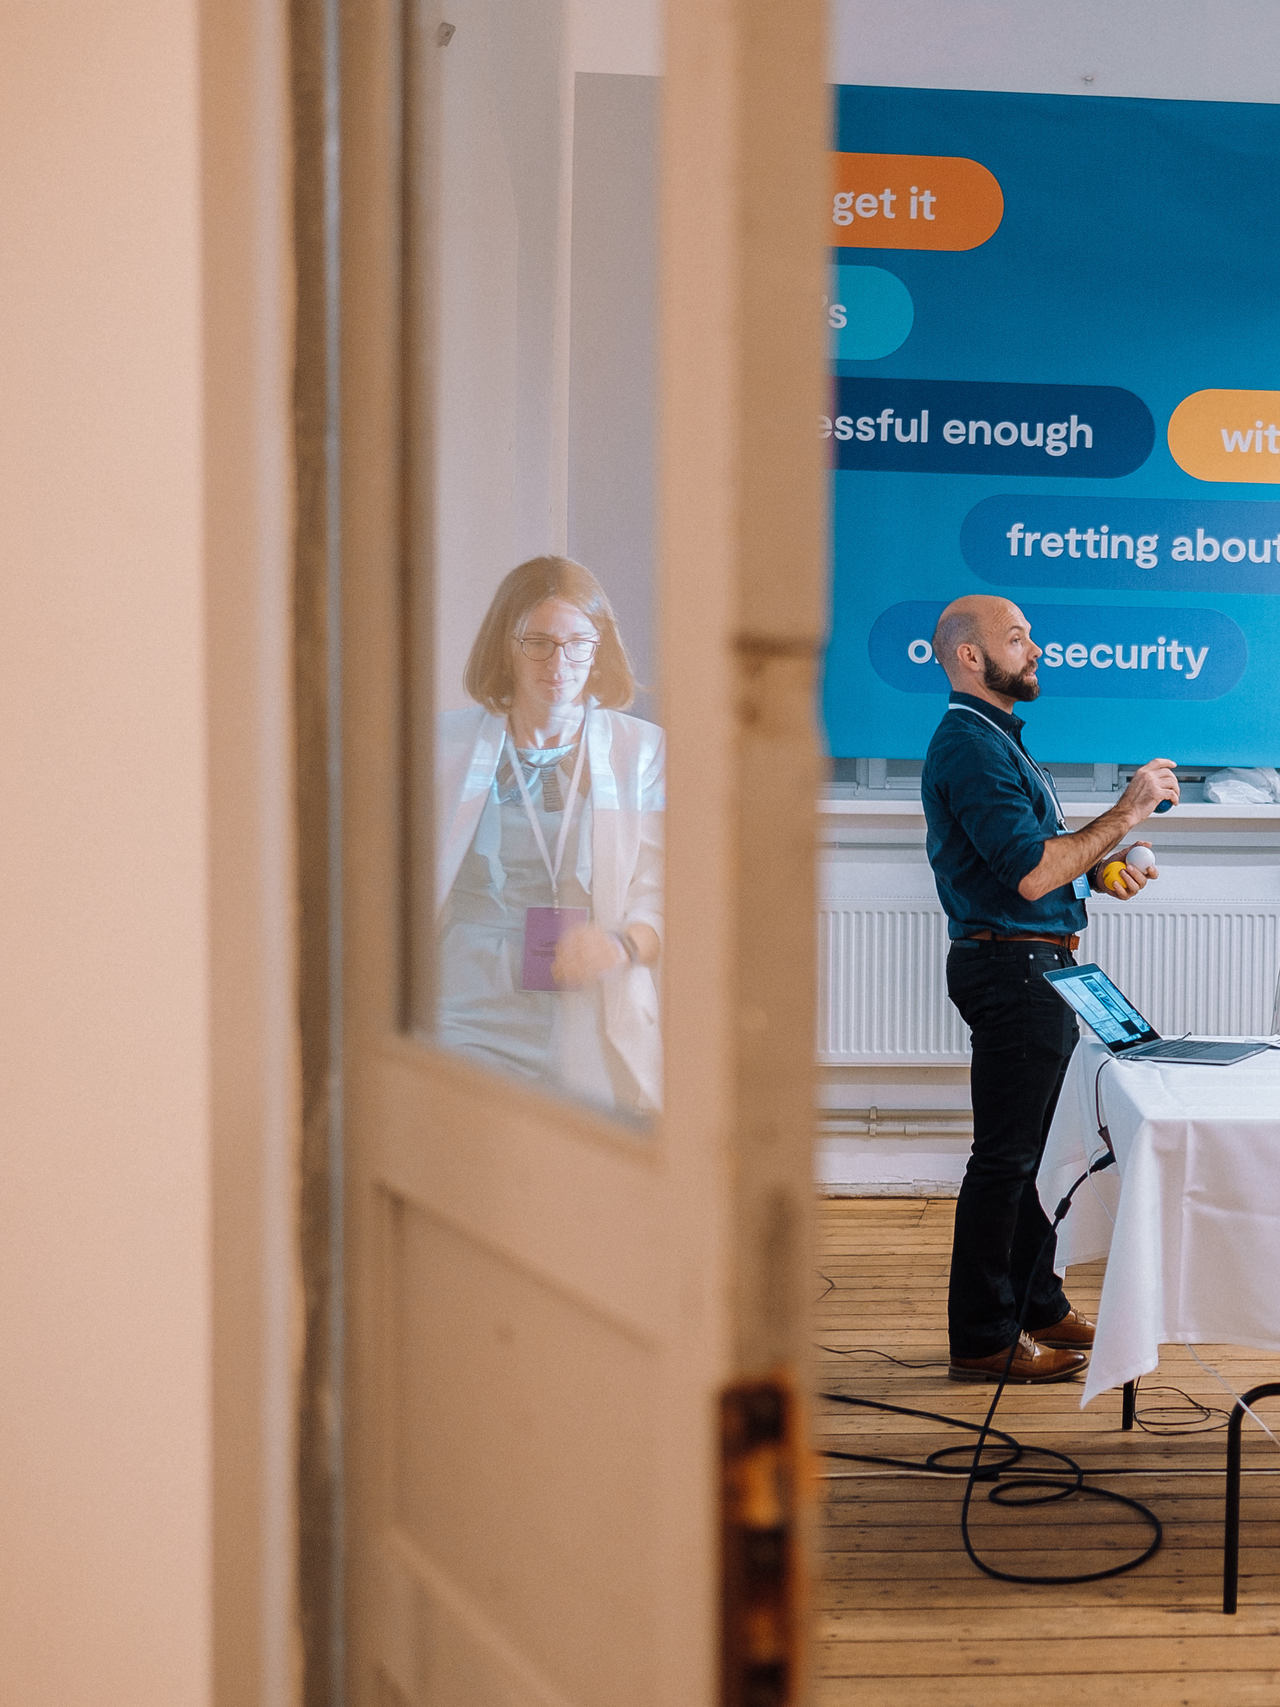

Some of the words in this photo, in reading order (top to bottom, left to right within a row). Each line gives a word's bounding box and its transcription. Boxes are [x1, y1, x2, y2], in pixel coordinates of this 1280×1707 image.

[832, 188, 897, 226] get
[909, 185, 937, 221] it
[942, 414, 1094, 455] enough
[1006, 522, 1159, 569] fretting
[1043, 635, 1210, 681] security
